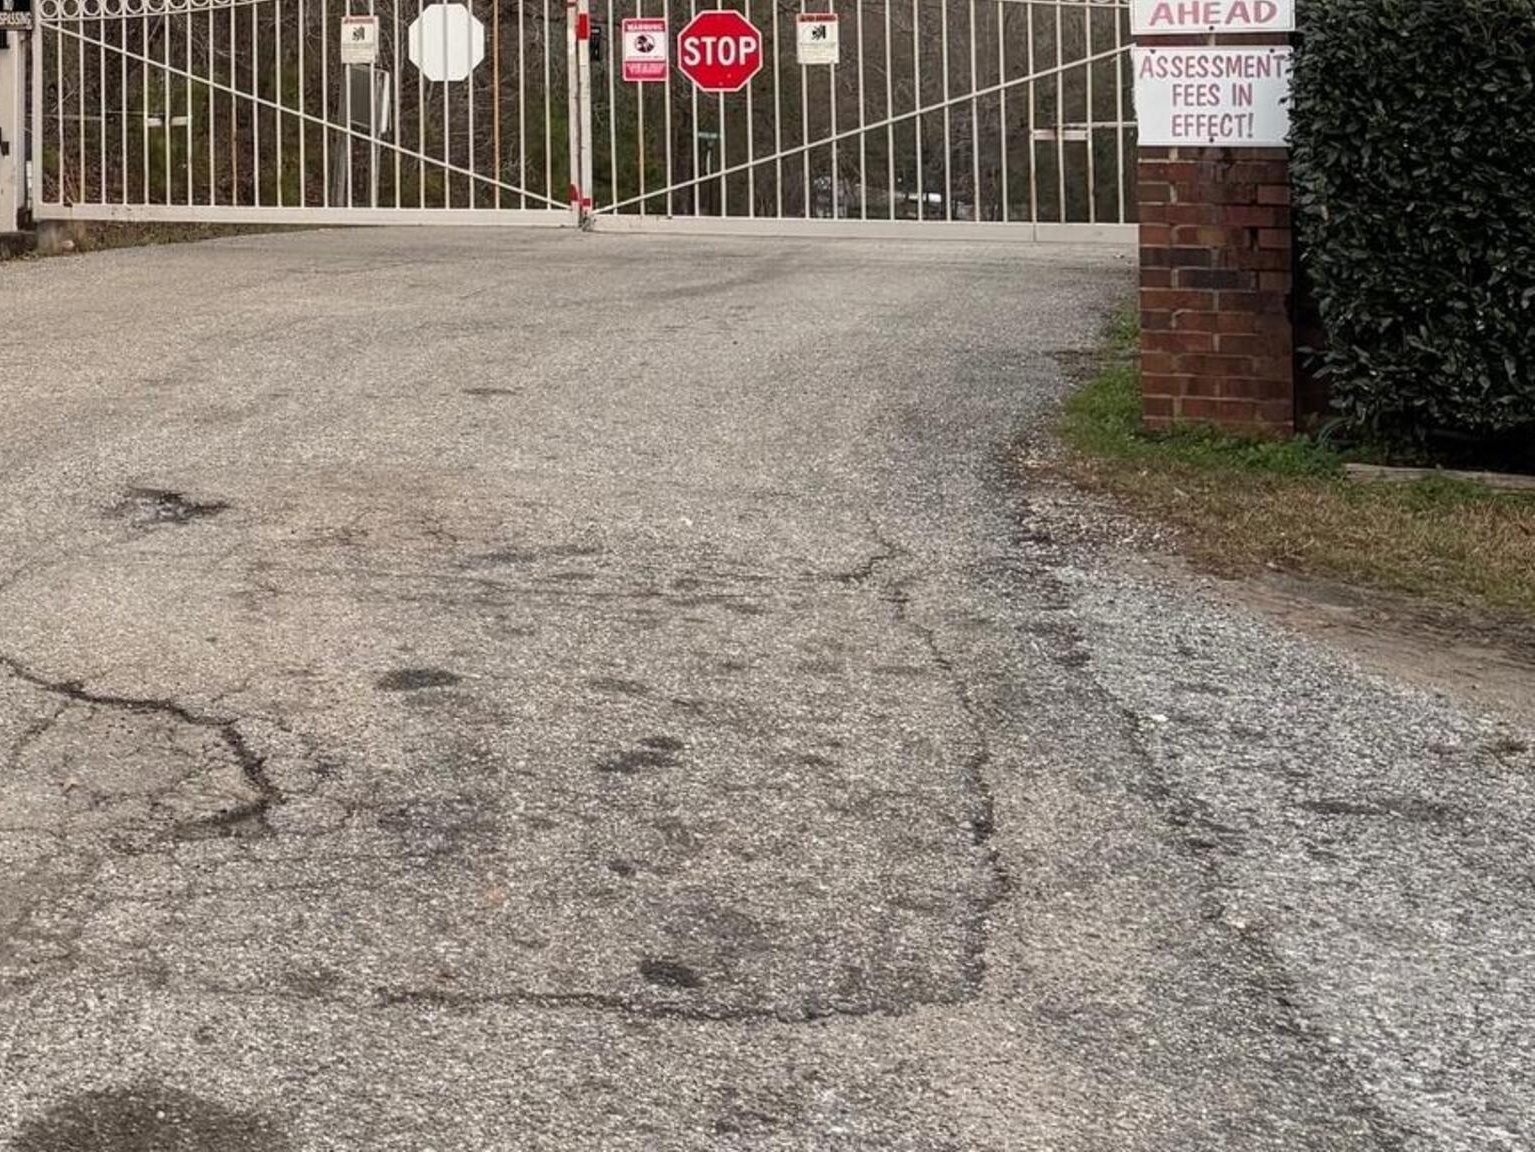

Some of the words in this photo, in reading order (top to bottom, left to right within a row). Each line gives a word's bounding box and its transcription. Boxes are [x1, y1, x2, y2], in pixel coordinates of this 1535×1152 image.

[1149, 0, 1278, 27] AHEAD
[684, 36, 757, 66] STOP
[1139, 54, 1286, 79] ASSESSMENT
[1172, 83, 1220, 107] FEES
[1232, 83, 1253, 107] IN
[1172, 113, 1254, 139] EFFECT!
